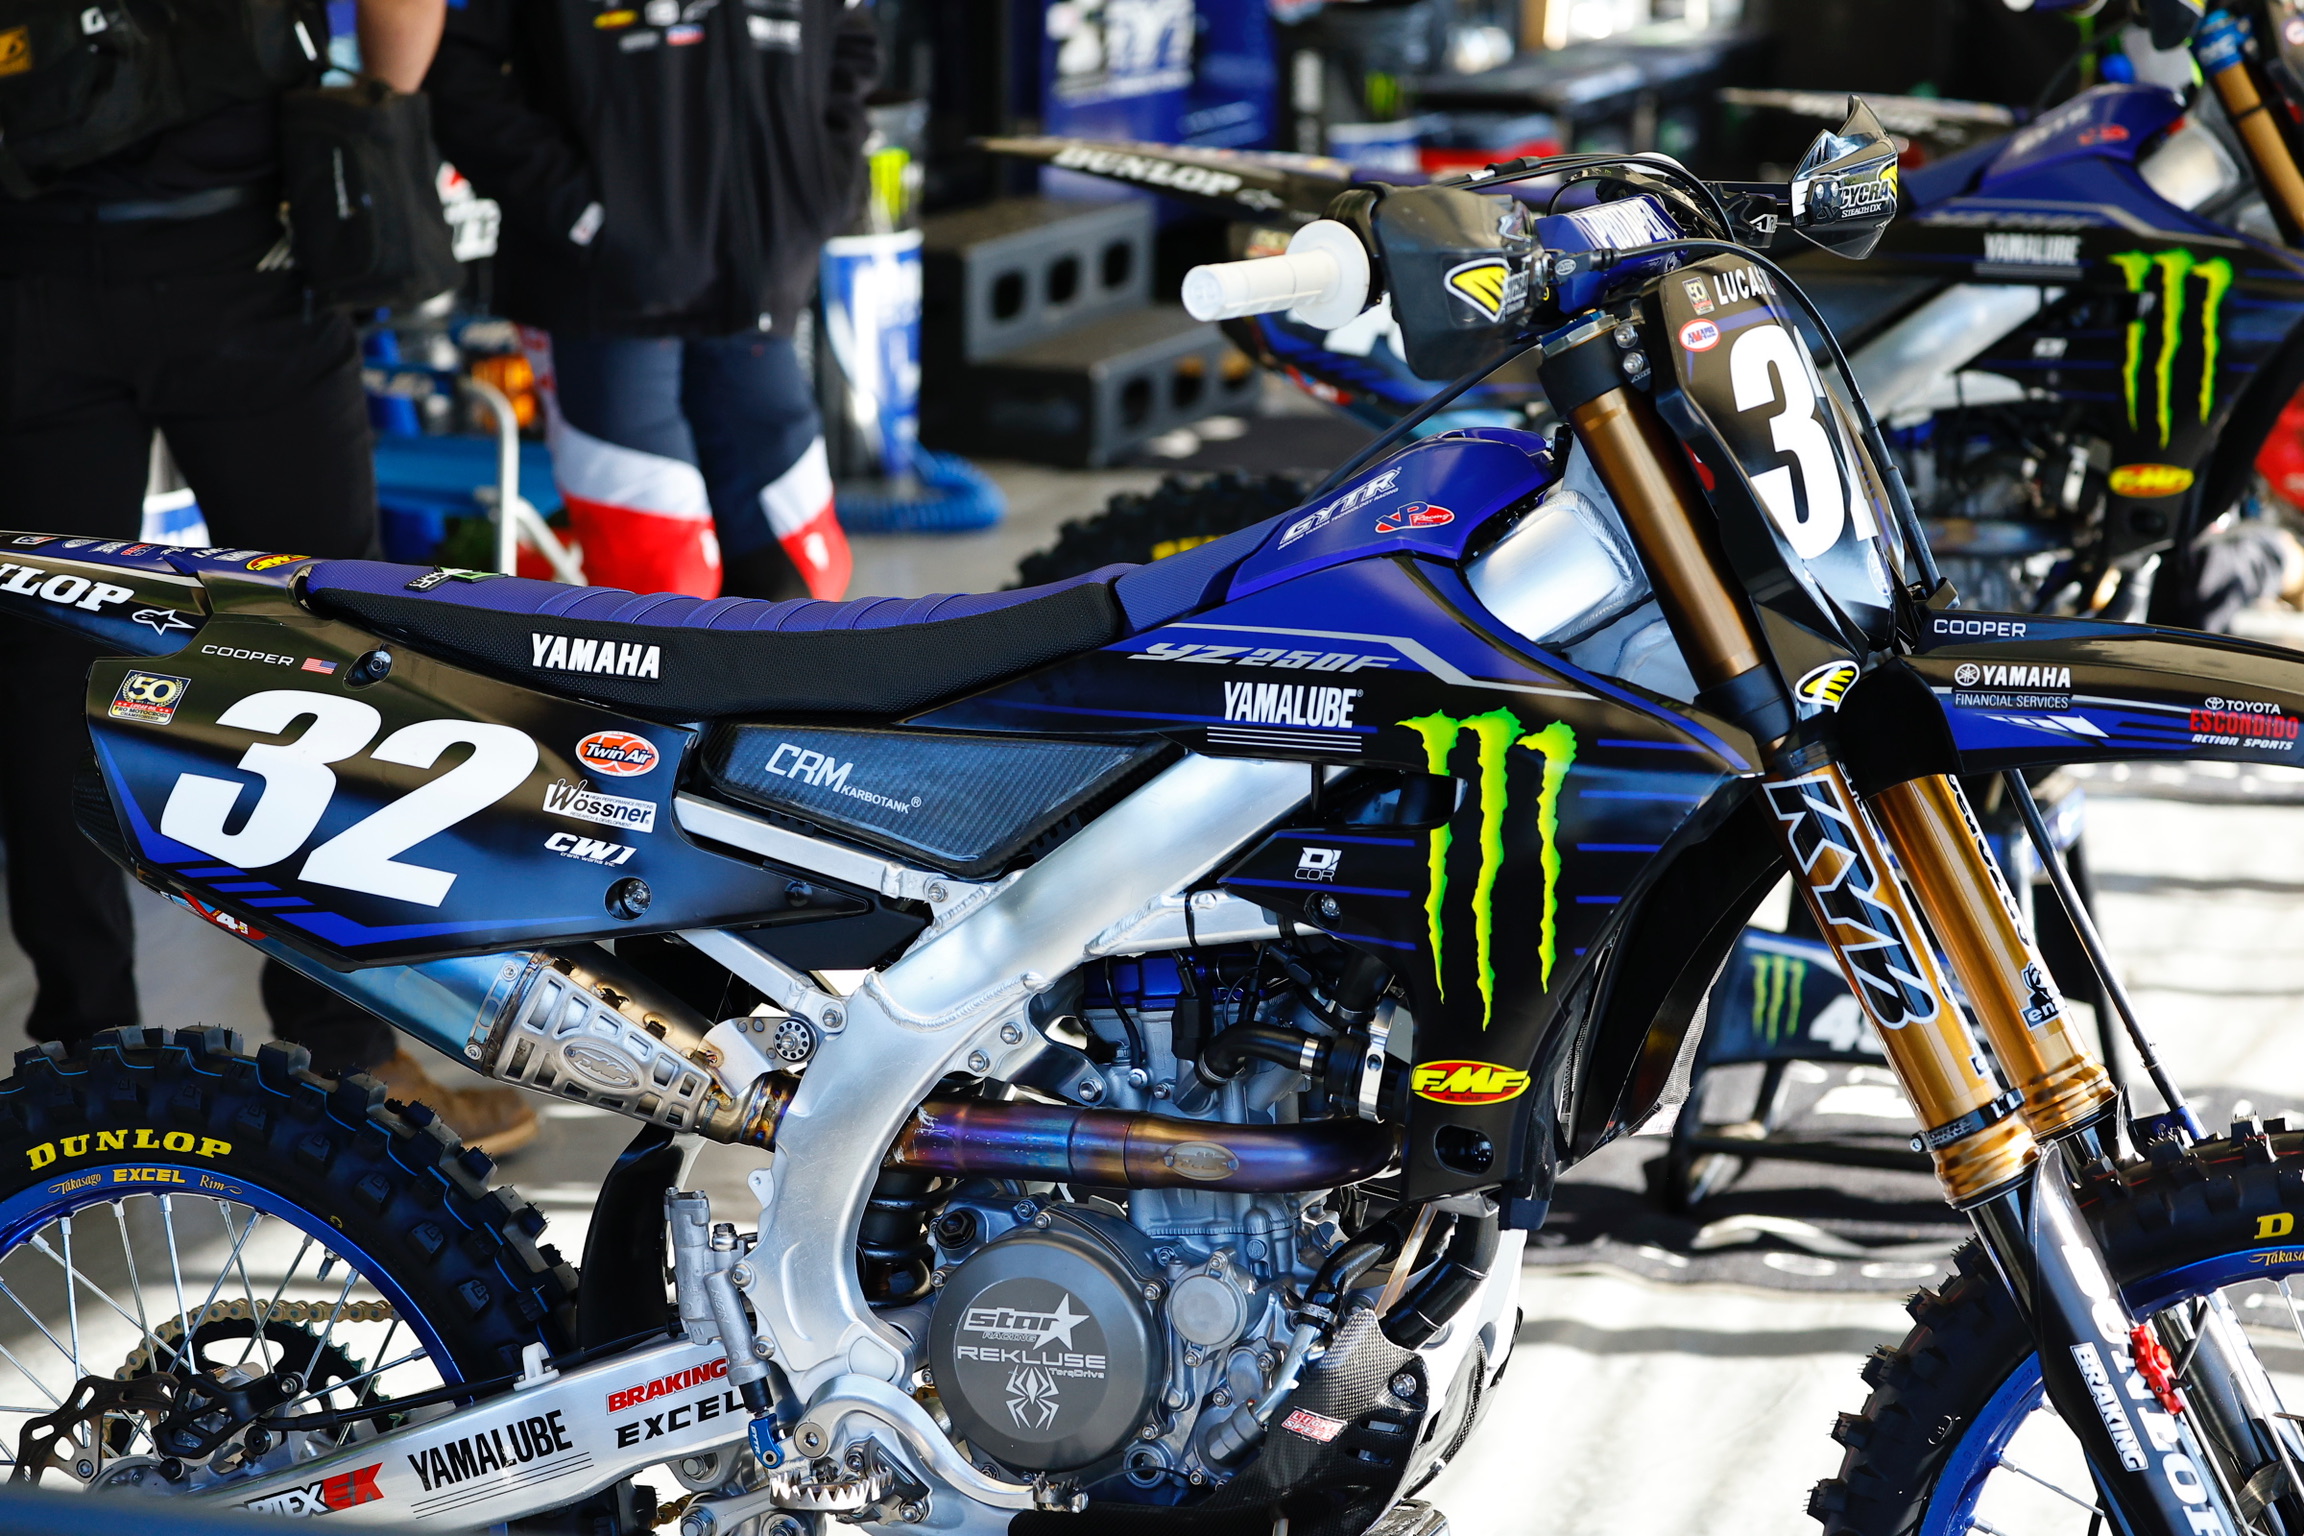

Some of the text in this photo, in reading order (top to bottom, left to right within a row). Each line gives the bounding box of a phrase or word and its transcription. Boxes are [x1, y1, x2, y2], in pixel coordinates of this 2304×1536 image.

[1054, 145, 1241, 196] DUNLOP
[1842, 203, 1882, 218] STEALTH DX
[1984, 232, 2080, 265] YAMALUBE
[1280, 467, 1401, 546] GYTR
[1305, 521, 1331, 536] YAMAHA
[1331, 499, 1374, 522] TECHNOLOGY
[1374, 487, 1399, 502] RACING
[1376, 501, 1429, 528] VP
[1934, 619, 2027, 637] COOPER
[200, 643, 295, 666] COOPER
[531, 632, 661, 680] YAMAHA
[1127, 642, 1400, 673] YZ250F
[127, 676, 178, 703] 50
[1982, 665, 2071, 688] YAMAHA
[129, 708, 169, 718] MOTOCROSS
[1955, 693, 2068, 709] FINANCIAL SERVICES
[2226, 699, 2281, 715] TOYOTA
[2189, 709, 2299, 739] ESCONDIDO
[585, 743, 654, 764] Twin Air
[2191, 734, 2294, 751] ACTION SPORTS
[764, 743, 854, 793] CRM
[160, 689, 541, 909] 32
[602, 796, 635, 807] PERFORMANCE
[635, 801, 654, 810] PISTONS
[570, 811, 595, 820] RESEARCH
[599, 817, 632, 828] DEVELOPMENT
[544, 832, 637, 865] CWI
[560, 851, 580, 860] crank
[581, 856, 604, 865] works
[1294, 868, 1335, 882] COR
[1762, 774, 1940, 1030] KYB
[1411, 1066, 1529, 1094] FMF
[26, 1129, 232, 1171] DUNLOP
[49, 1173, 237, 1195] Takasago Rim
[113, 1168, 186, 1184] EXCEL
[982, 1331, 1037, 1342] RACING
[957, 1345, 1106, 1369] REKLUSE
[606, 1357, 728, 1415] BRAKING
[1048, 1367, 1105, 1379] TorqDrive
[615, 1390, 745, 1449] EXCEL
[2070, 1342, 2149, 1470] BRAKING
[1283, 1419, 1335, 1442] SPEED
[407, 1408, 573, 1492] YAMALUBE
[322, 1462, 385, 1511] EK
